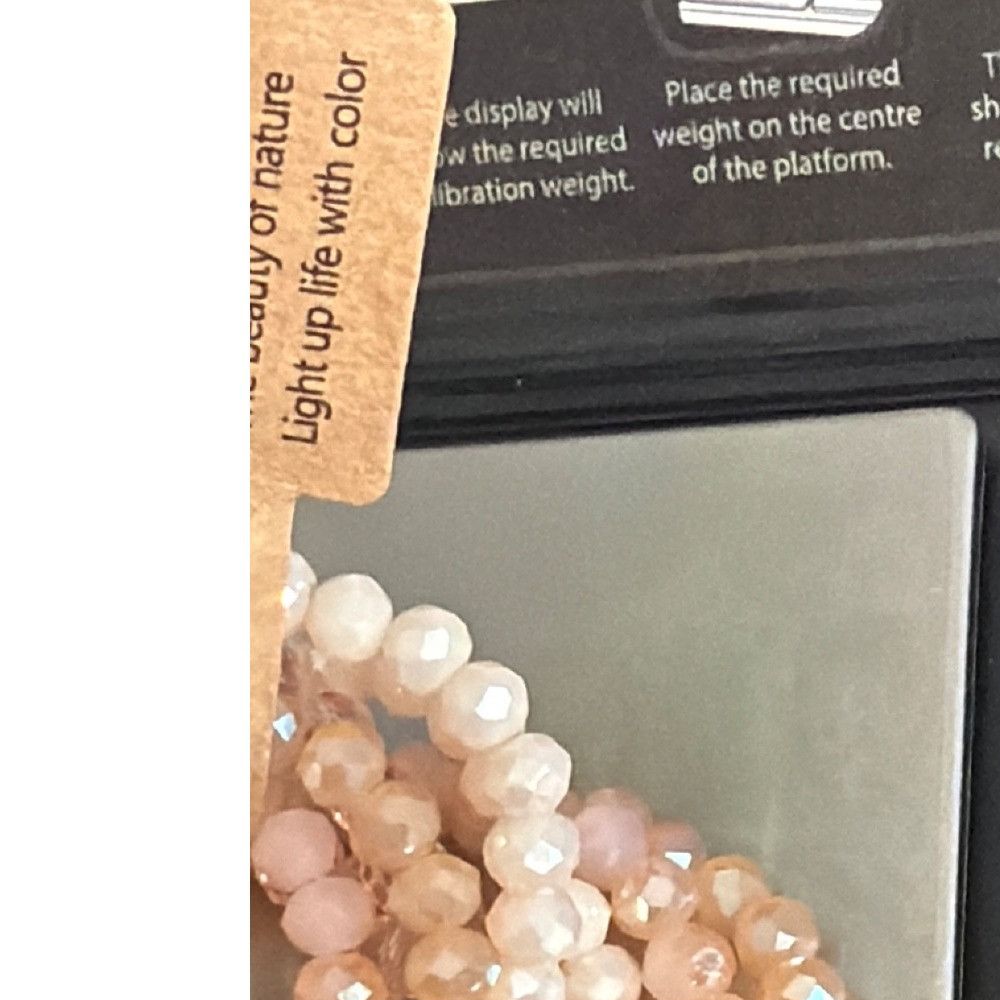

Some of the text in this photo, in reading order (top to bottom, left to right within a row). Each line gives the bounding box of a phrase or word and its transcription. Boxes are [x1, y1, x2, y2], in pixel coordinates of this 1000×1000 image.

[665, 58, 902, 107] Place the required
[252, 71, 295, 190] nature
[464, 95, 554, 131] display
[558, 87, 603, 117] will
[652, 103, 923, 151] weight on the centre
[437, 124, 628, 169] ow the required
[692, 144, 893, 185] of the platform.
[431, 167, 635, 207] libration weight.
[281, 51, 369, 445] Light up life with color
